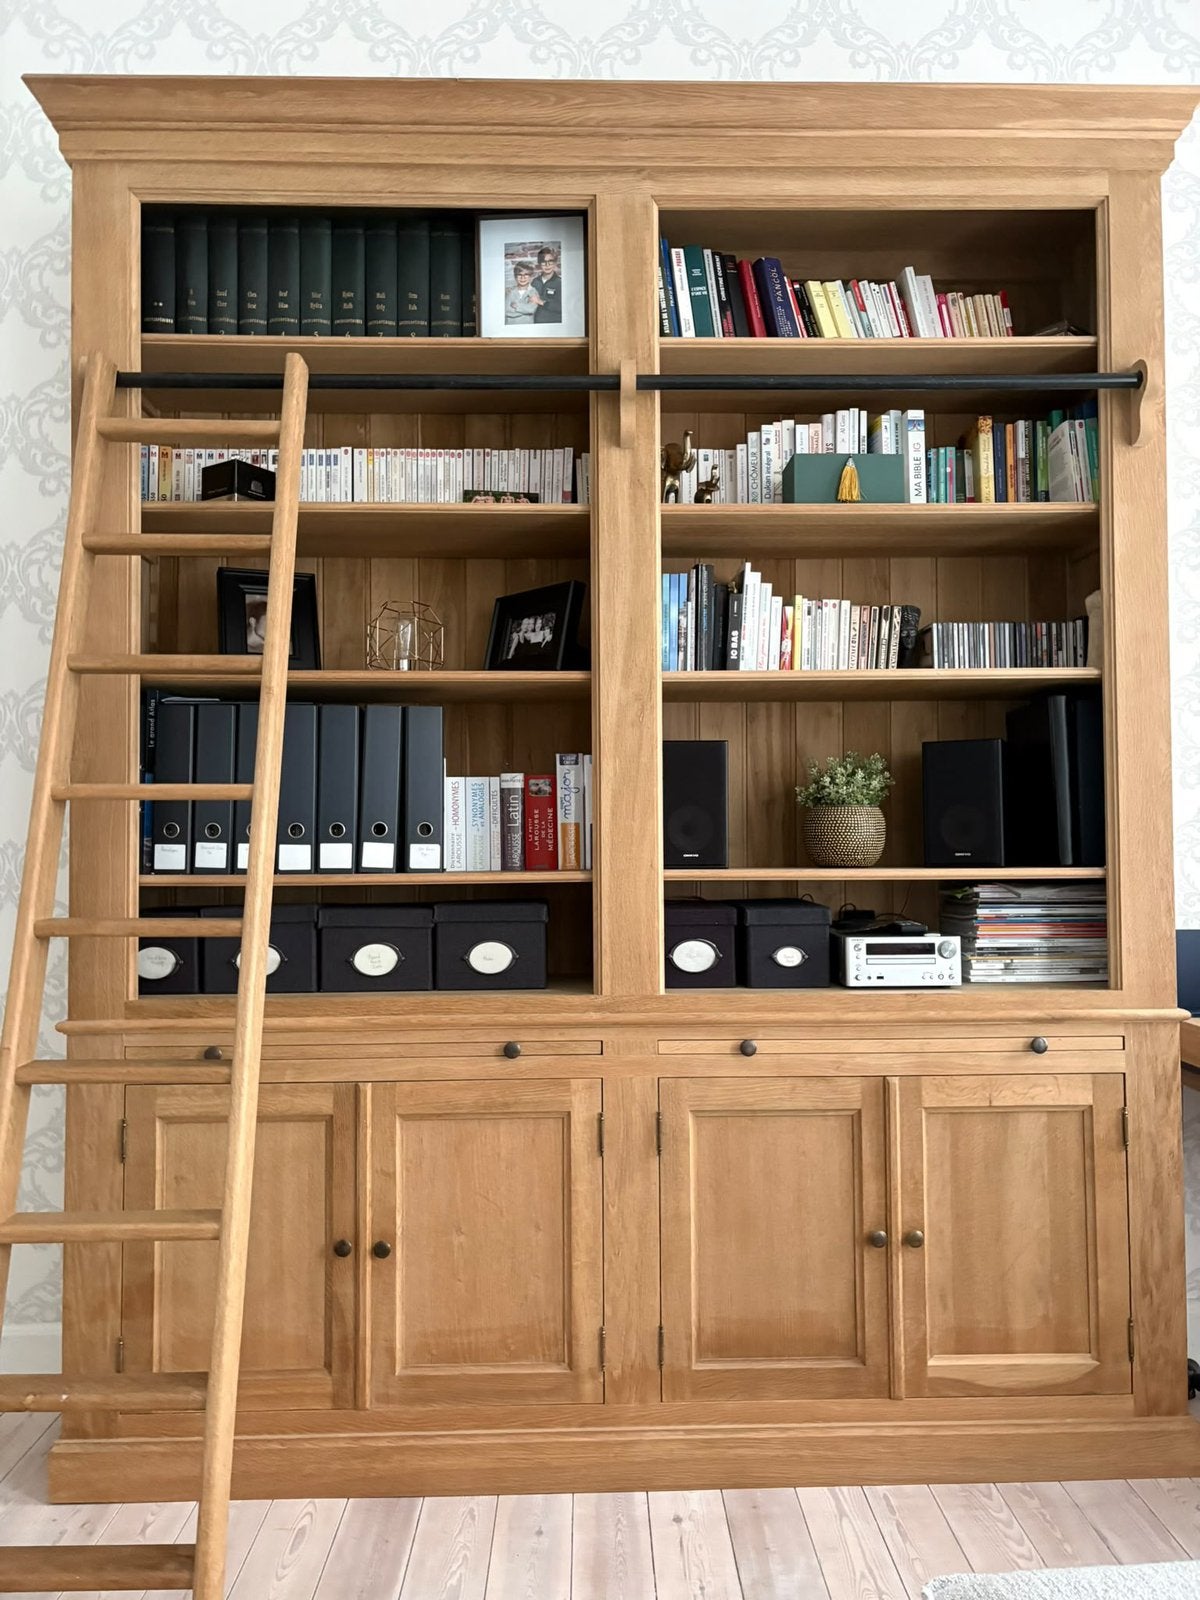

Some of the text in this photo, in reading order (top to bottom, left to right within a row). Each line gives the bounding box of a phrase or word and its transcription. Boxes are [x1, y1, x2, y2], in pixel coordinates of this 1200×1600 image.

[715, 255, 726, 301] CHRISTINE OCKRENT
[770, 267, 784, 302] PANCOL
[749, 452, 758, 490] CHÔMEUR
[913, 442, 922, 497] MA BIBLE IG
[148, 740, 155, 748] Le
[451, 781, 460, 826] HOMONYMES
[506, 795, 519, 827] Latin
[561, 768, 580, 819] major
[546, 807, 554, 851] MÉDECINE
[512, 833, 520, 867] LAROUSSE
